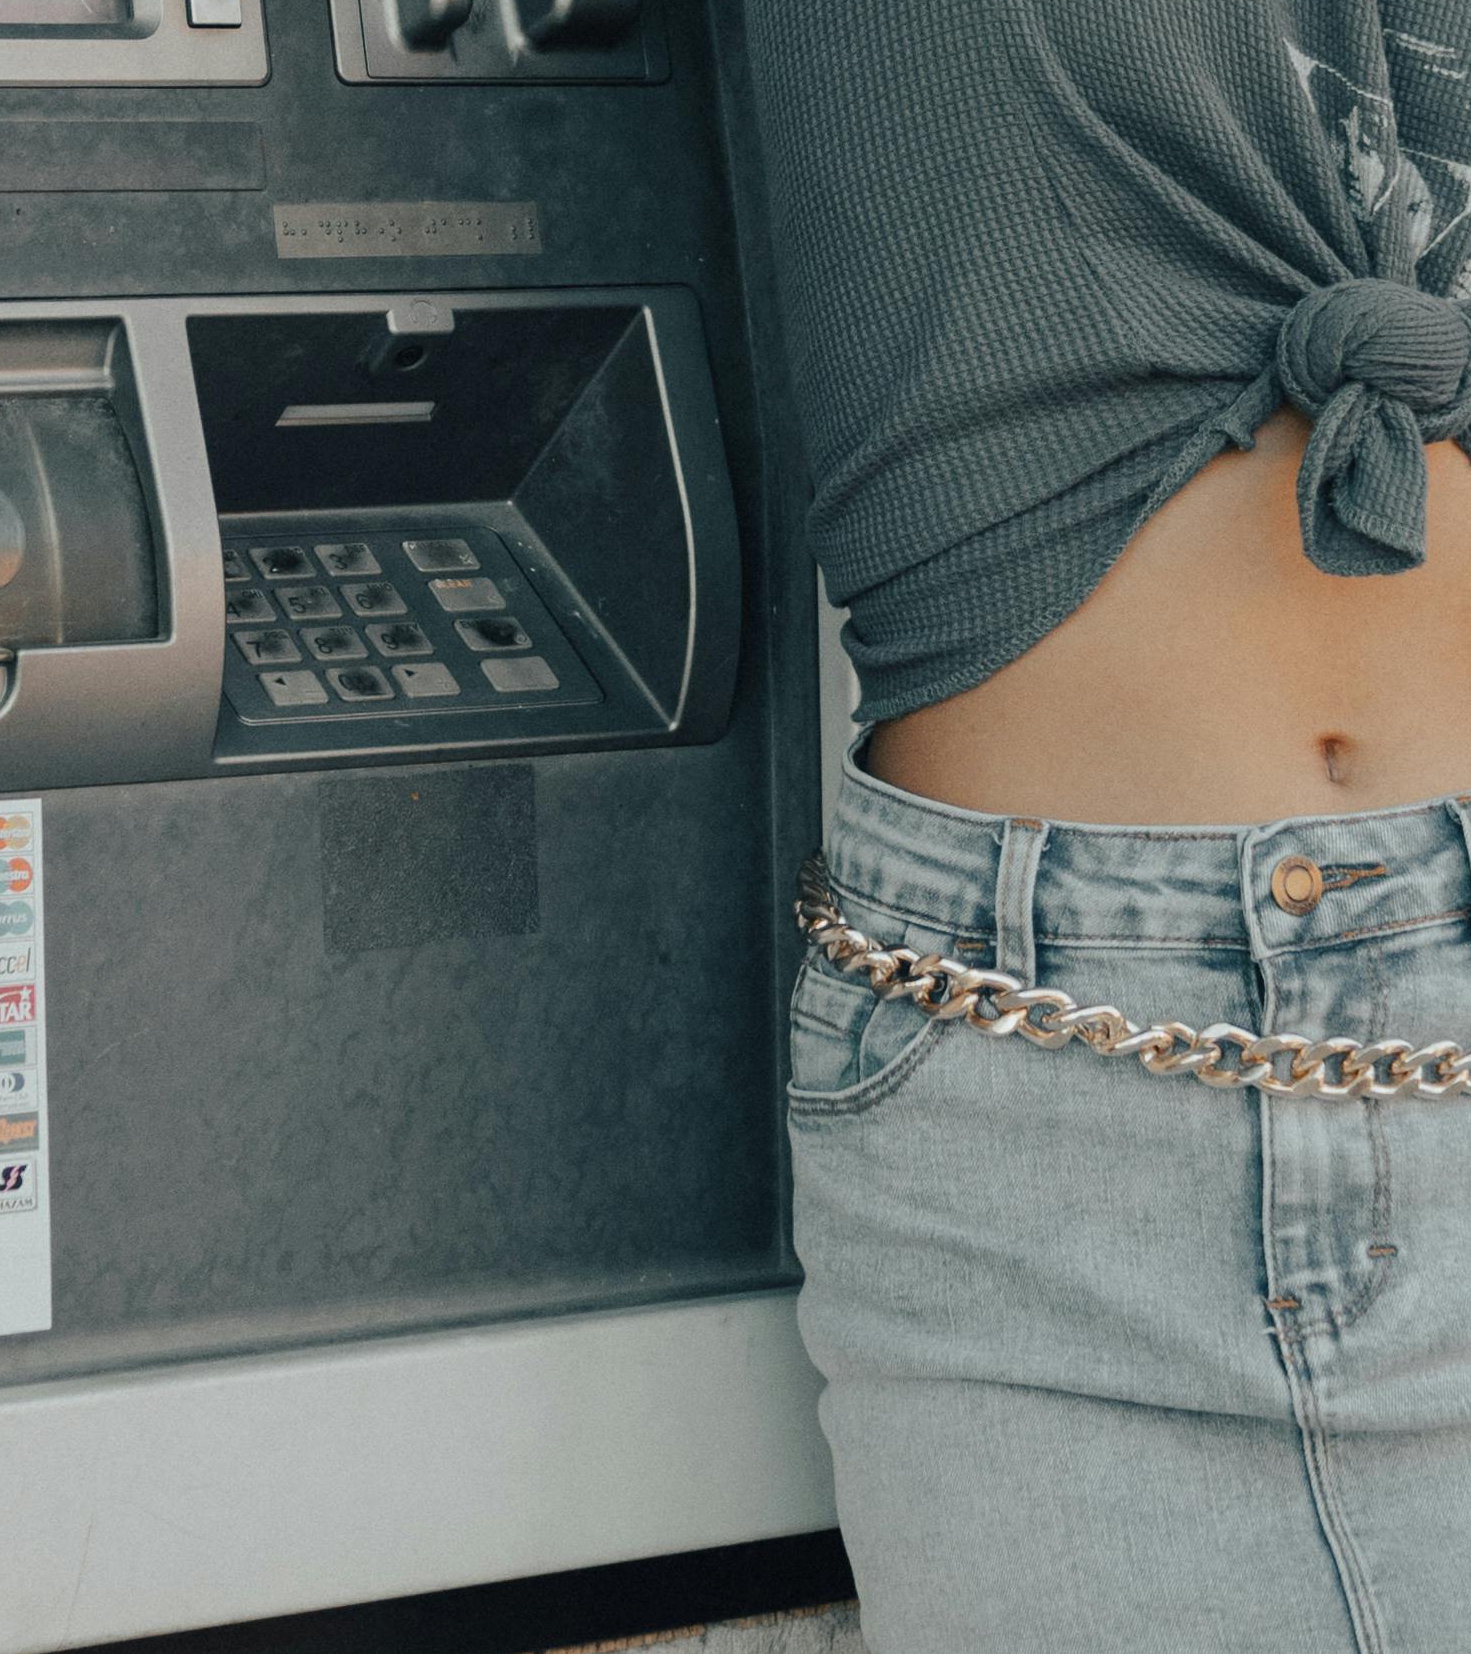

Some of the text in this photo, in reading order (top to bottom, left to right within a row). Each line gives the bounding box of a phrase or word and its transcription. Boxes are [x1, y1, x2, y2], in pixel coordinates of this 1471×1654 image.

[329, 554, 348, 570] 3
[288, 596, 307, 615] 5
[355, 593, 375, 611] 6
[246, 640, 262, 658] 7
[314, 636, 334, 654] 8
